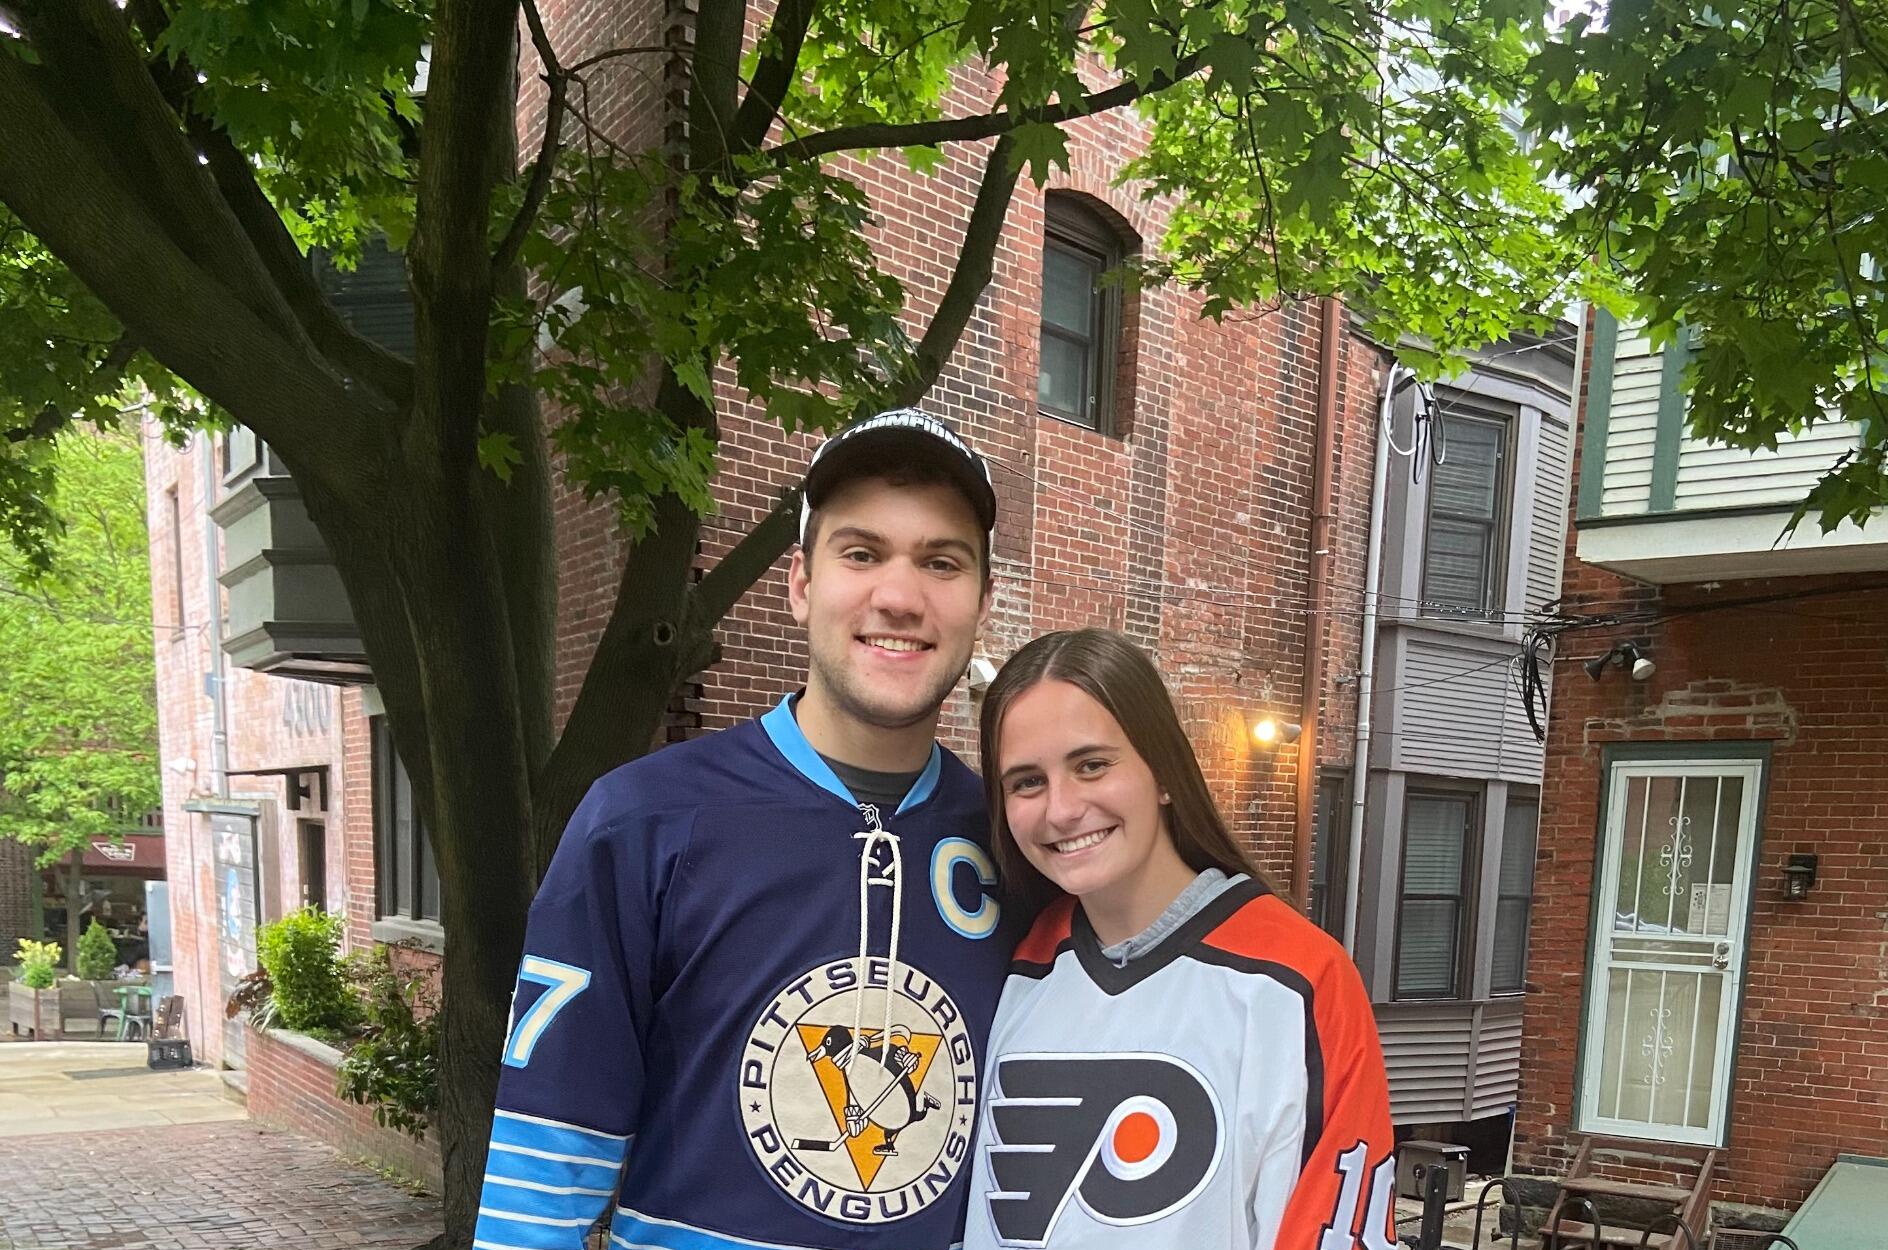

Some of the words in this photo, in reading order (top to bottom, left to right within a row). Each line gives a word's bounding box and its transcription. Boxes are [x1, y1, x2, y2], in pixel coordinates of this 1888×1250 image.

[929, 836, 1000, 940] C
[501, 954, 592, 1069] 7
[751, 1123, 967, 1221] PENGUINS
